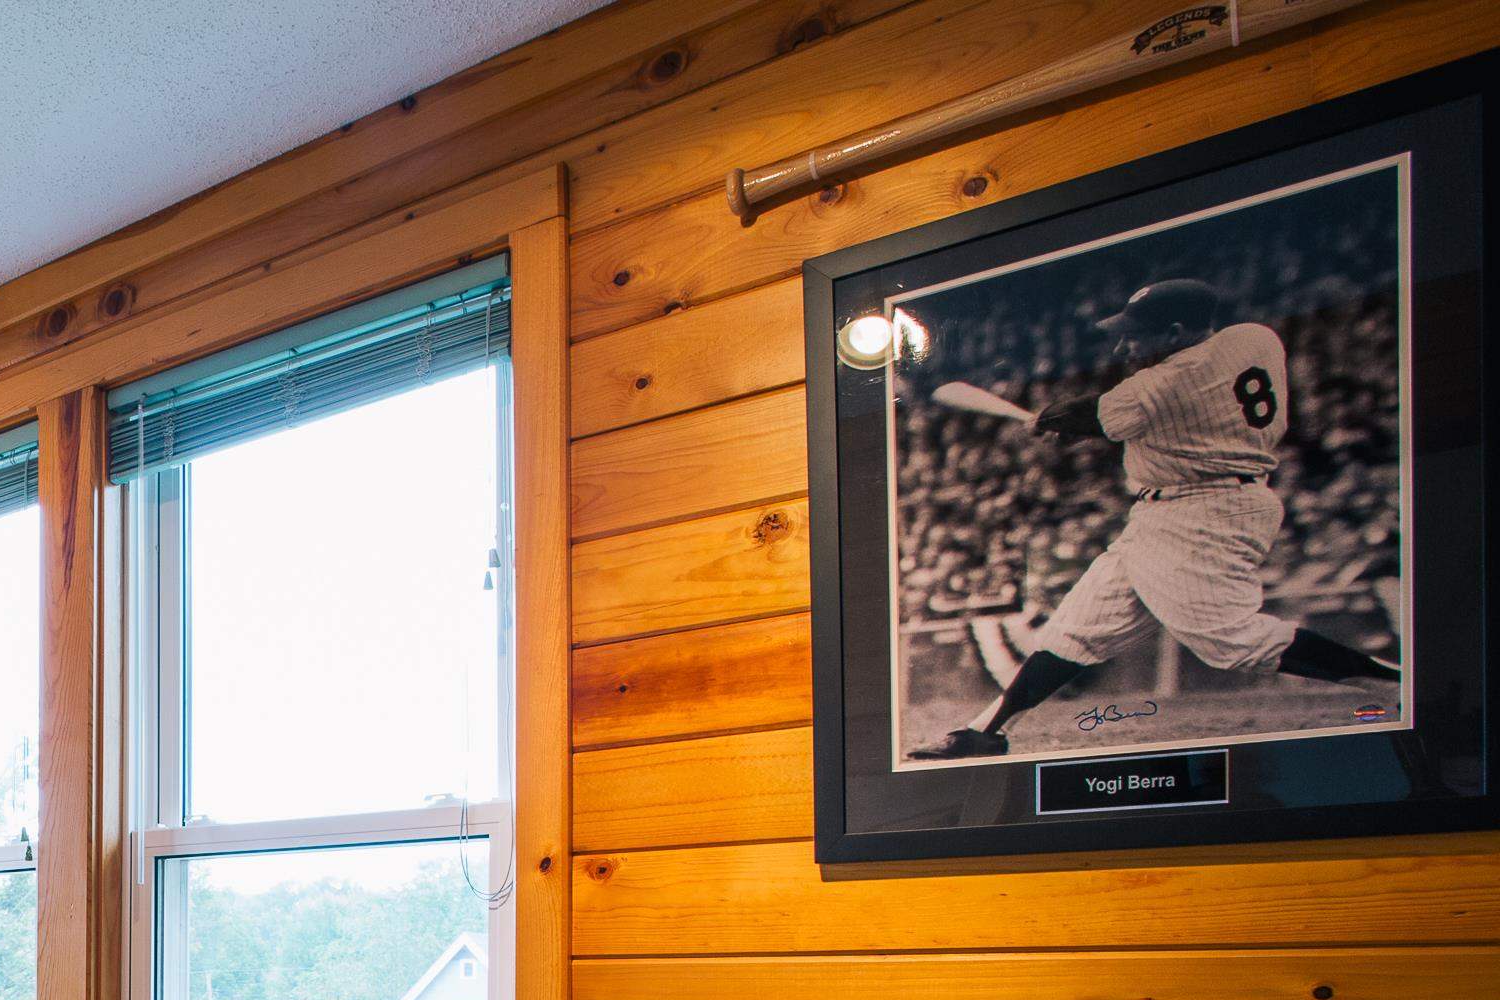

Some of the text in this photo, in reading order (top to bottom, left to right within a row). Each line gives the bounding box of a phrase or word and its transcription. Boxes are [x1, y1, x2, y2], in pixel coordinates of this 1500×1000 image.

[1148, 9, 1211, 36] LEGENDS
[1233, 366, 1278, 430] 8
[1085, 775, 1176, 795] Yogi Berra
